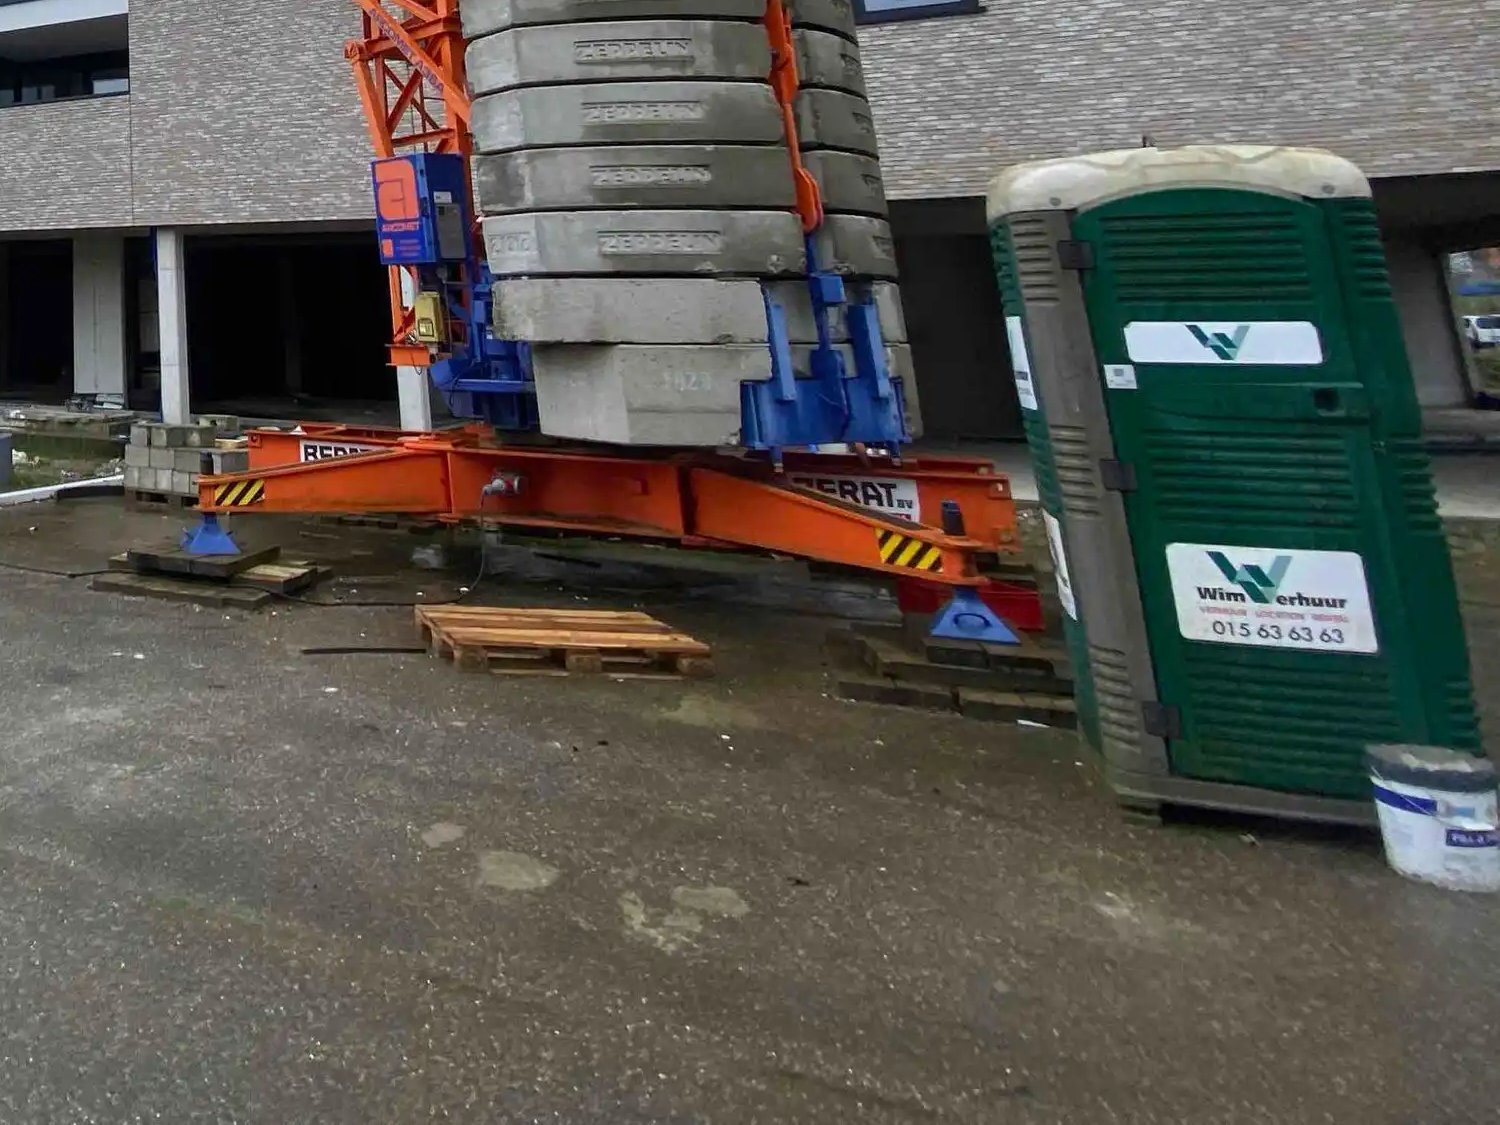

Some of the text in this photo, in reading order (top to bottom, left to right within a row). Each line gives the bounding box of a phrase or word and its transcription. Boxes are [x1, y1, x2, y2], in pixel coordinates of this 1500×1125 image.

[575, 40, 691, 61] ZEPPELIN
[598, 232, 722, 254] ZEPPELIN
[1197, 586, 1246, 603] Wim
[1212, 620, 1345, 644] 015 63 63 63
